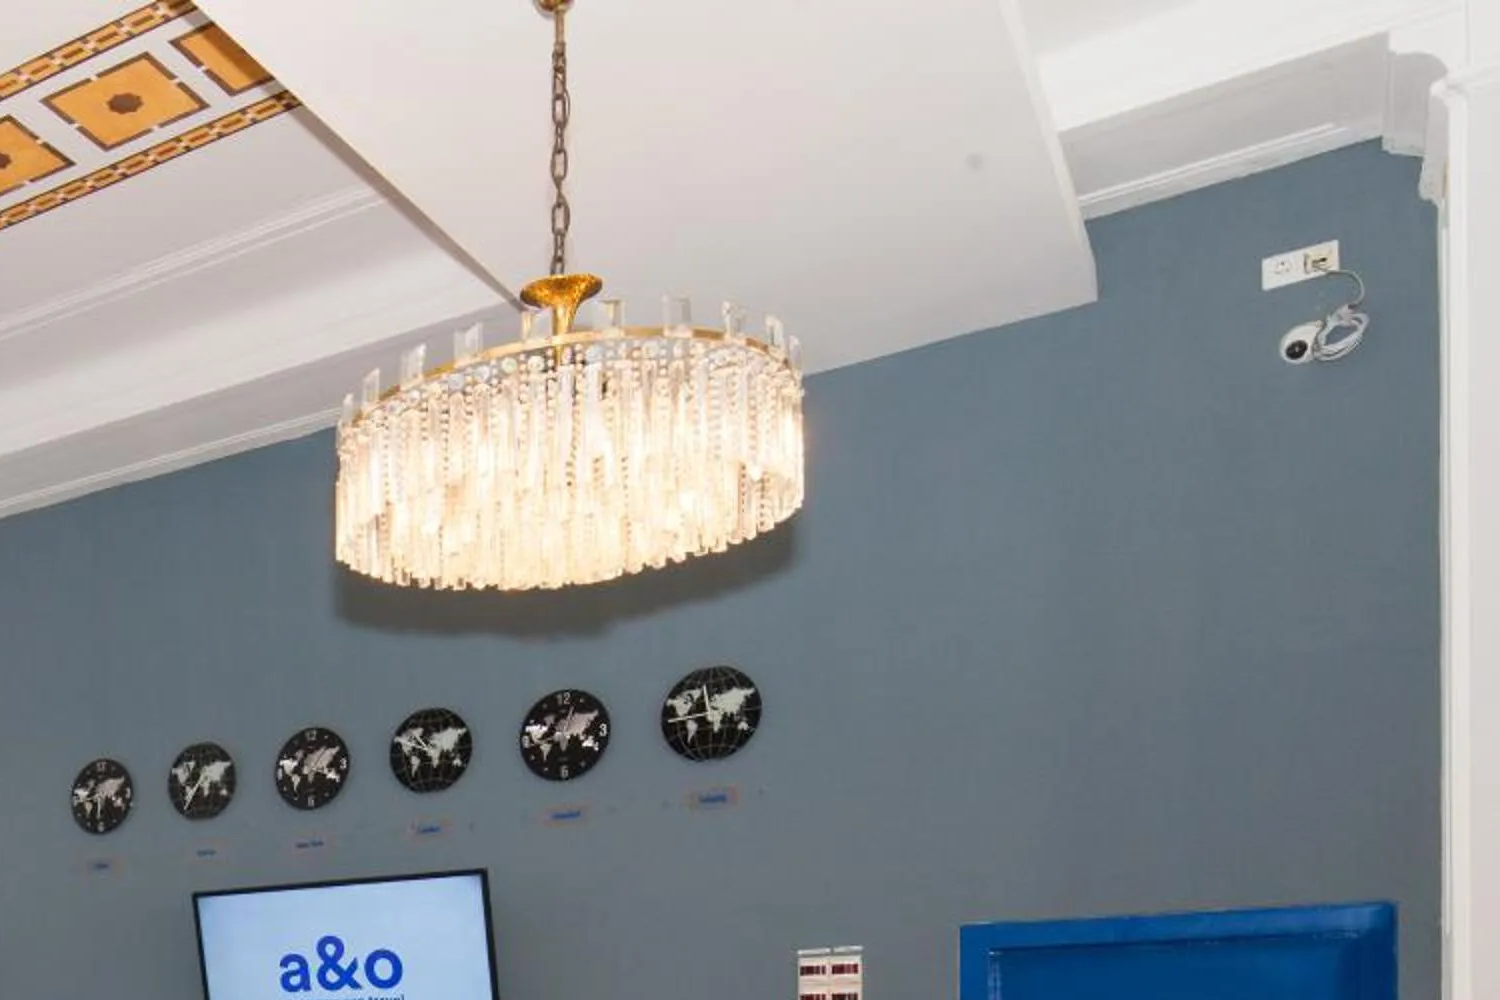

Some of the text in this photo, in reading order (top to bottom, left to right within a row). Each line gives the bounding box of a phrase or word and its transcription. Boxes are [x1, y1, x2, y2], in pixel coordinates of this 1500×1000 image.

[556, 692, 571, 705] 12
[599, 724, 608, 737] 3
[279, 934, 404, 993] a&o
